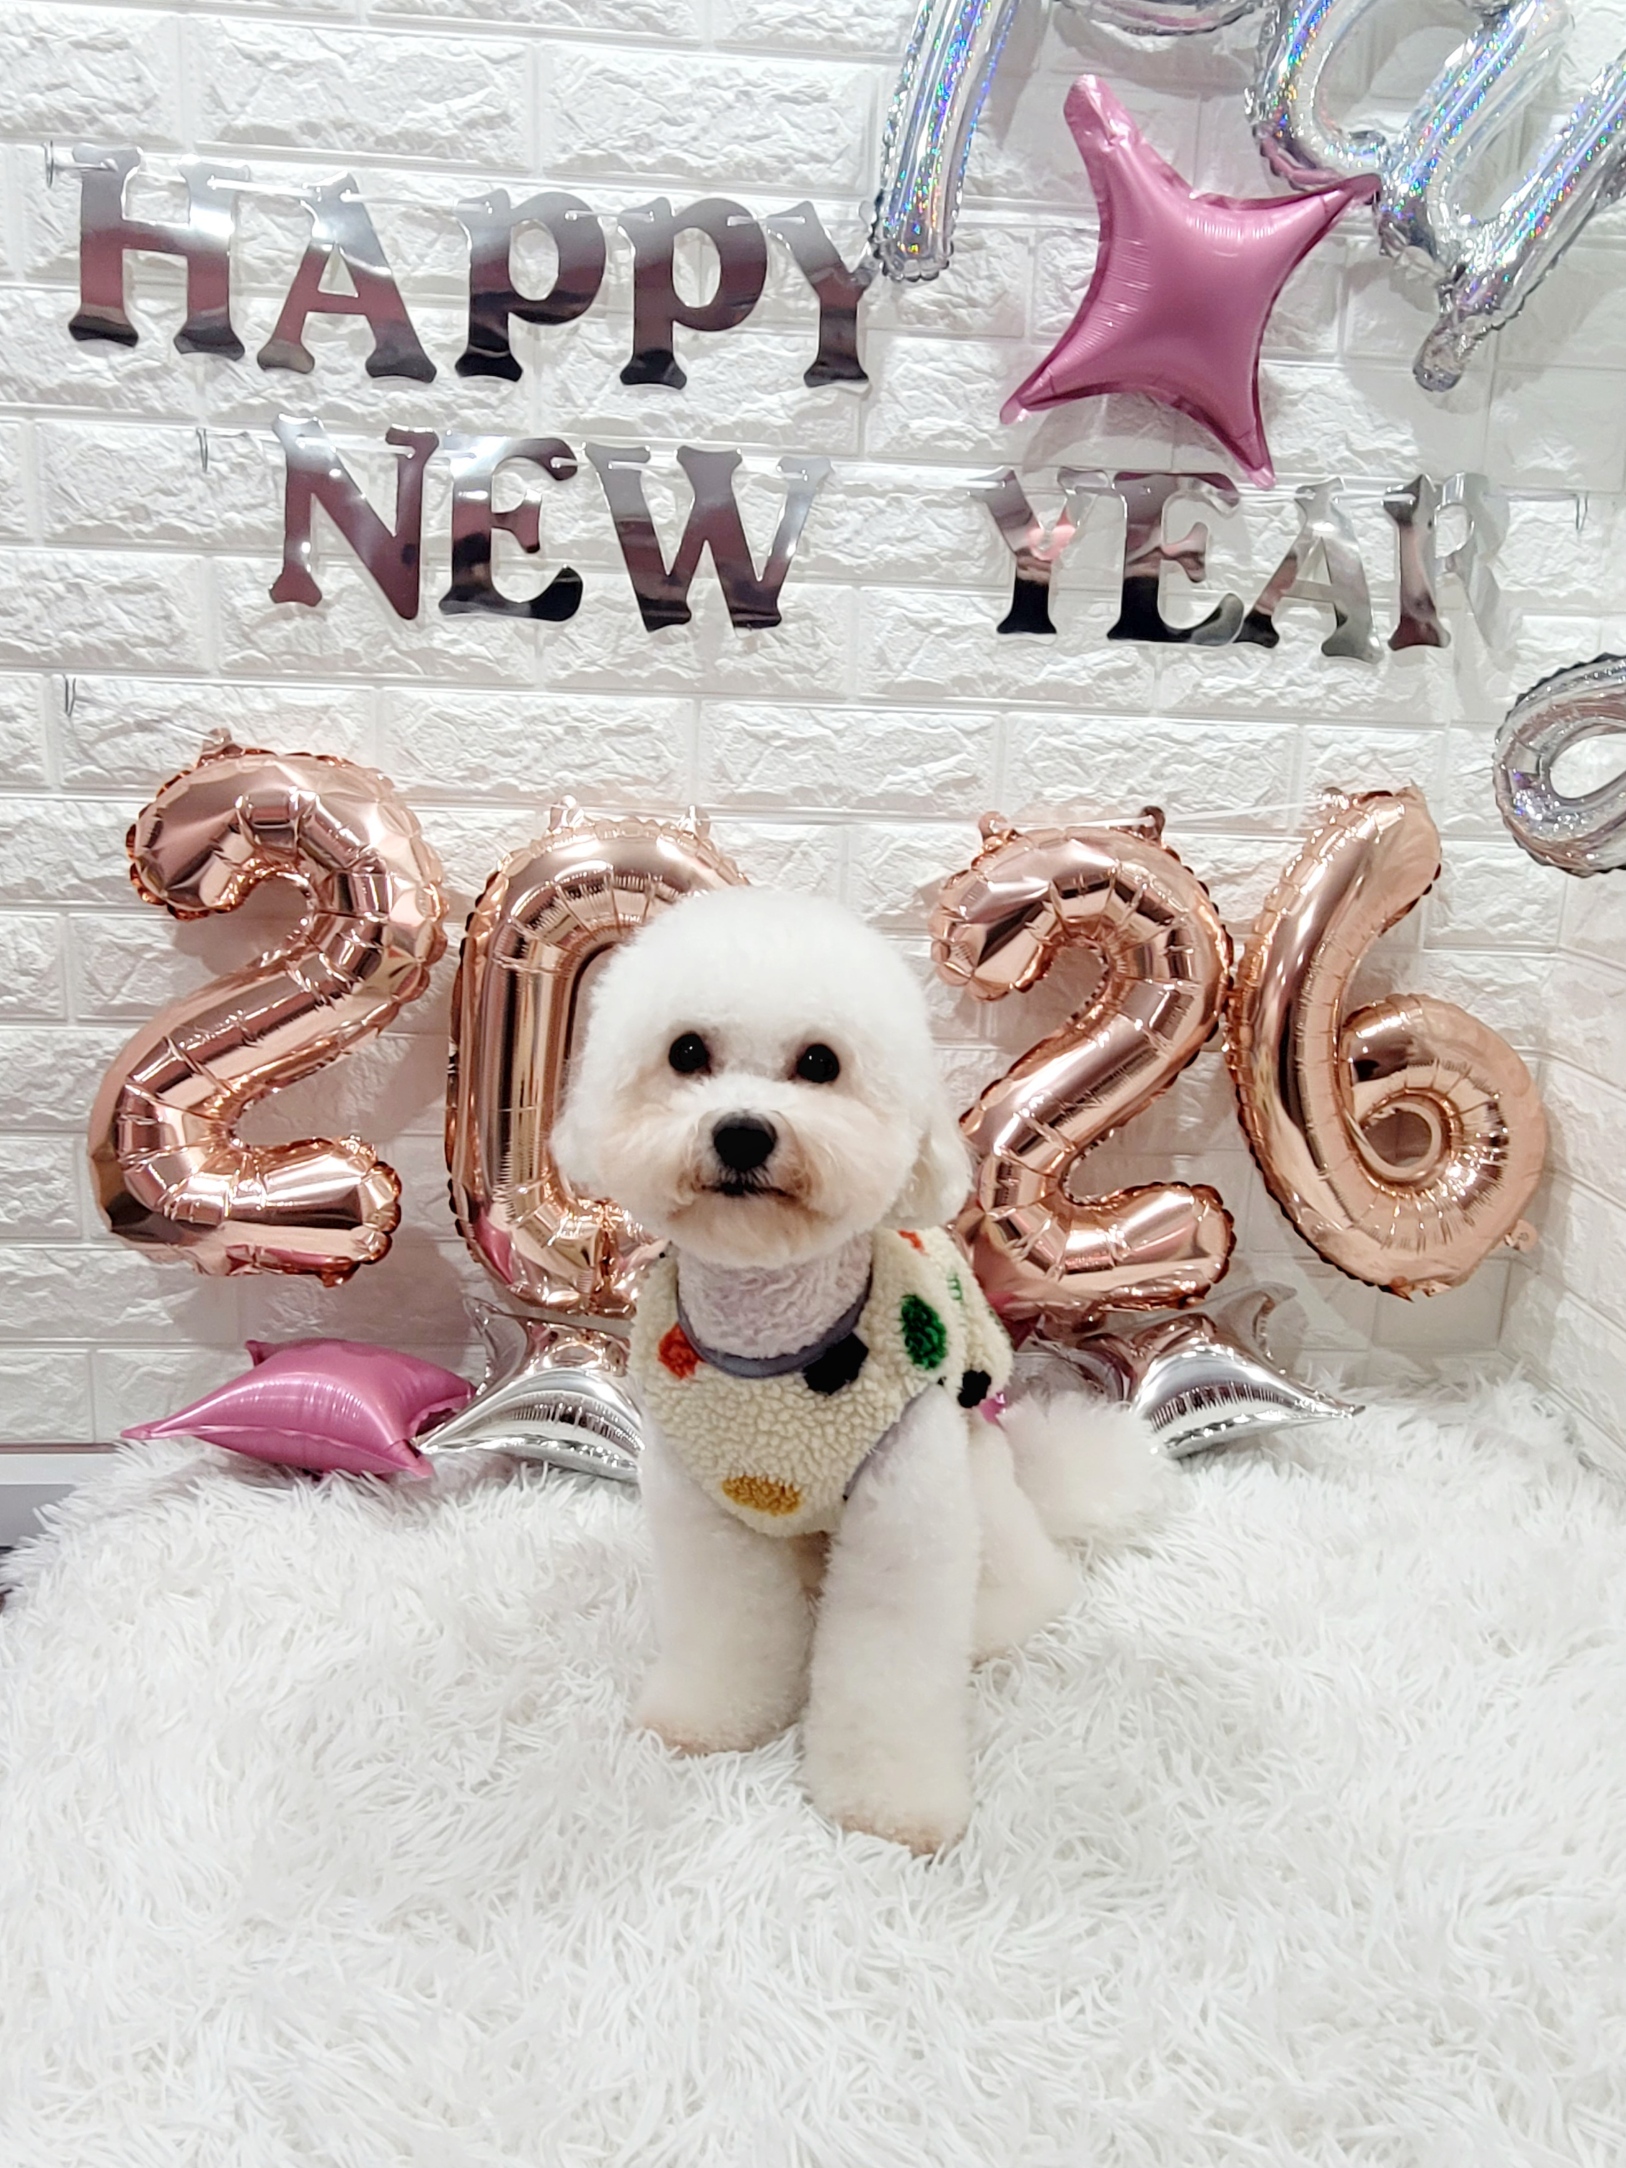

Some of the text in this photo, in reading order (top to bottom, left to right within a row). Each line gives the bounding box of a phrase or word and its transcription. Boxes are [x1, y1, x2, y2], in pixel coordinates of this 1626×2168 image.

[68, 145, 877, 388] HAPPY
[270, 413, 1511, 664] NEW YEAR
